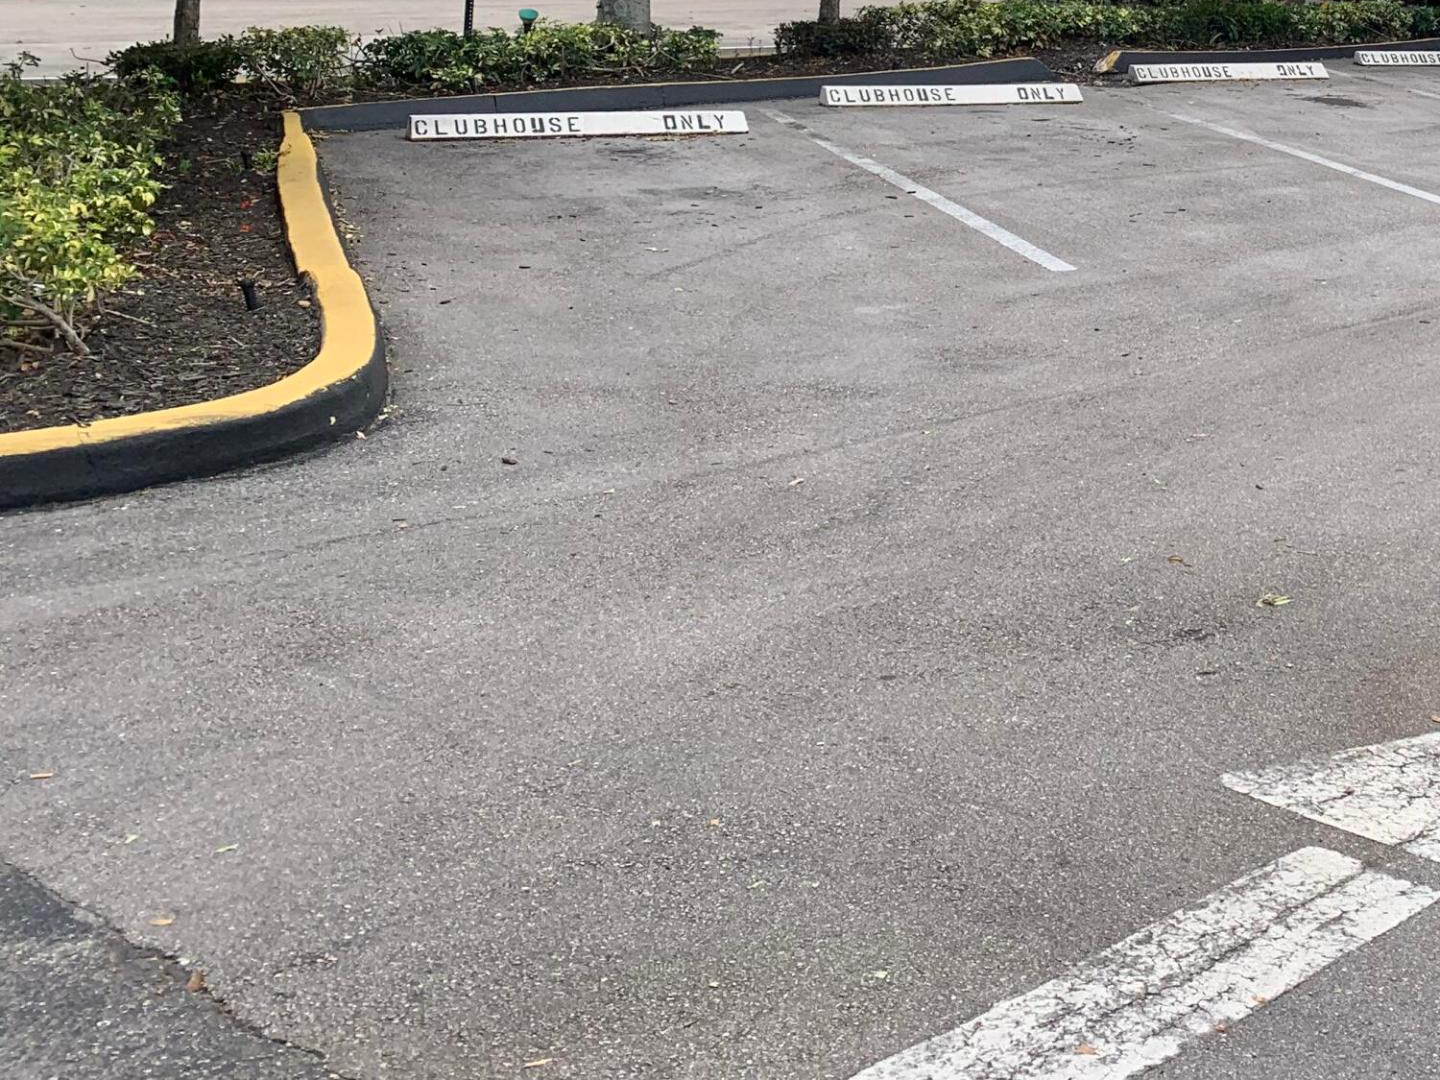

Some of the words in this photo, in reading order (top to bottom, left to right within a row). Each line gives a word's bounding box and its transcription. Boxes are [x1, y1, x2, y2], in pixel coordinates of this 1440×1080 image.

[1137, 65, 1233, 79] CLUBHOUSE
[1277, 65, 1316, 76] ONLY
[829, 88, 956, 103] CLUBHOUSE
[1016, 87, 1064, 100] ONLY
[415, 117, 582, 135] CLUBHOUSE
[662, 114, 724, 130] ONLY
